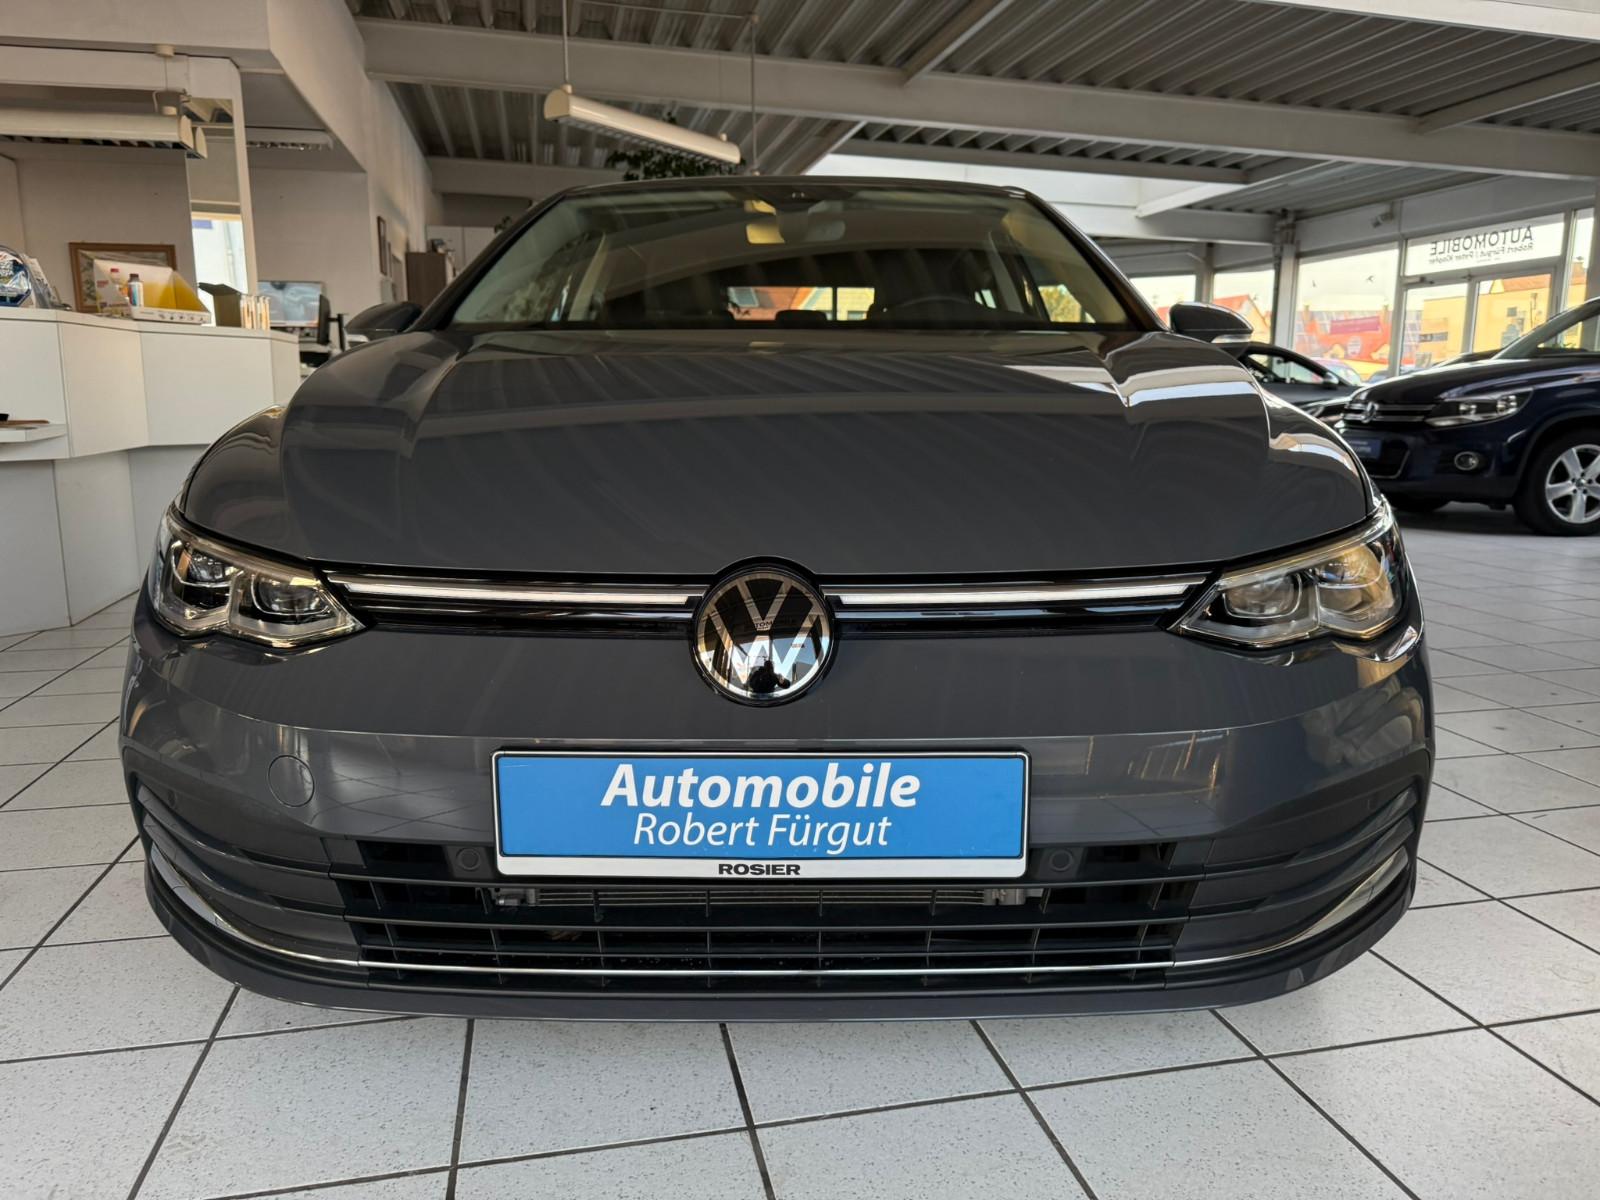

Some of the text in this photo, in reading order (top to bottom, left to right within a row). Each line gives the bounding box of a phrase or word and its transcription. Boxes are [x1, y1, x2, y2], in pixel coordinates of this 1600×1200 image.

[600, 762, 921, 808] Automobile
[633, 812, 892, 855] Robert Fürgut
[718, 863, 801, 876] ROSIER
